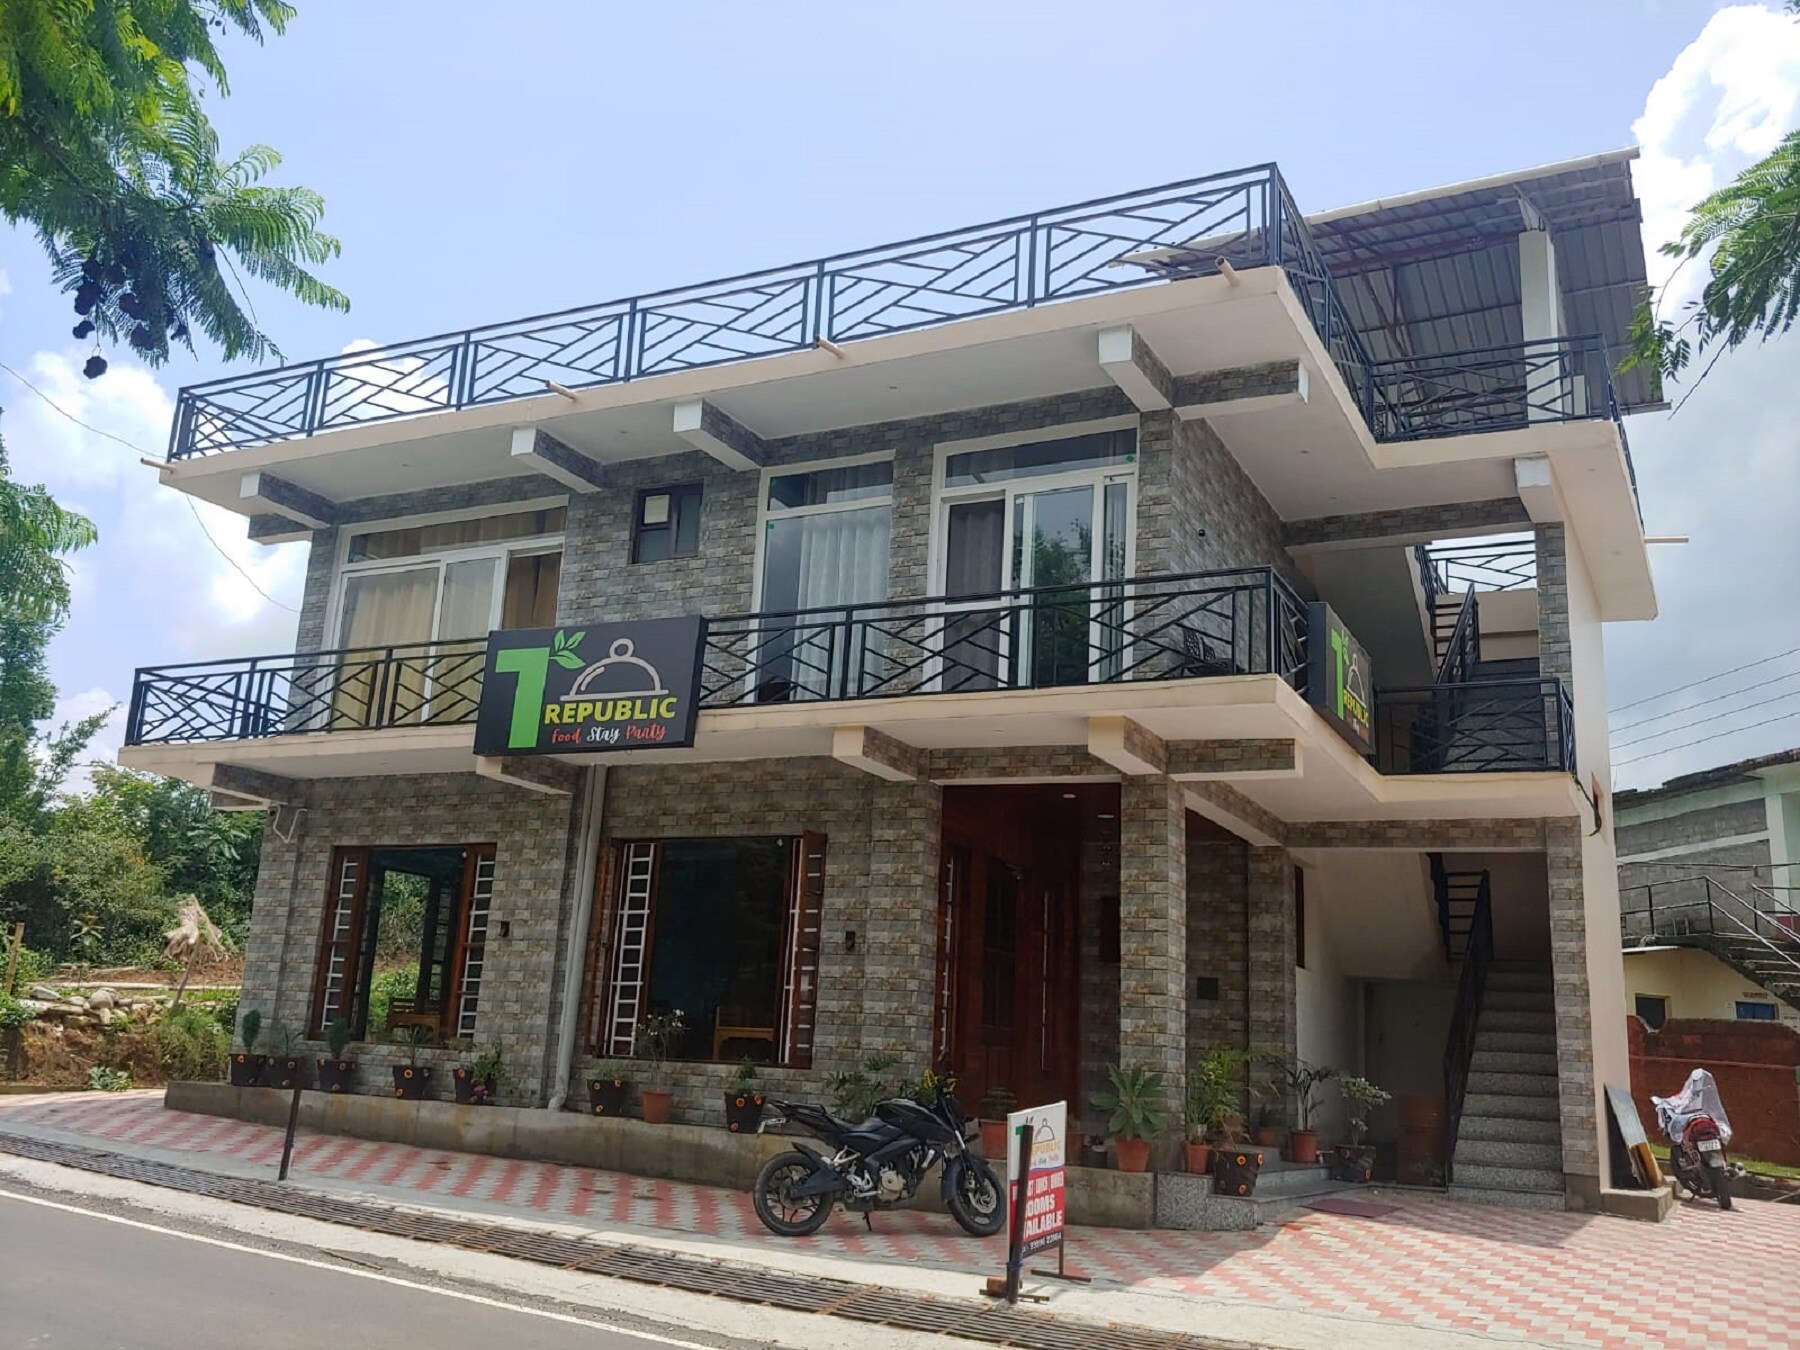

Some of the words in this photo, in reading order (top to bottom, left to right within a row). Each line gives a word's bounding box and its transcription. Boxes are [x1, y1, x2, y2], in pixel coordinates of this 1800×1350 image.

[544, 697, 677, 725] REPUBLIC
[586, 725, 621, 744] Stay
[626, 722, 667, 742] Party
[1025, 1193, 1056, 1219] OOMS
